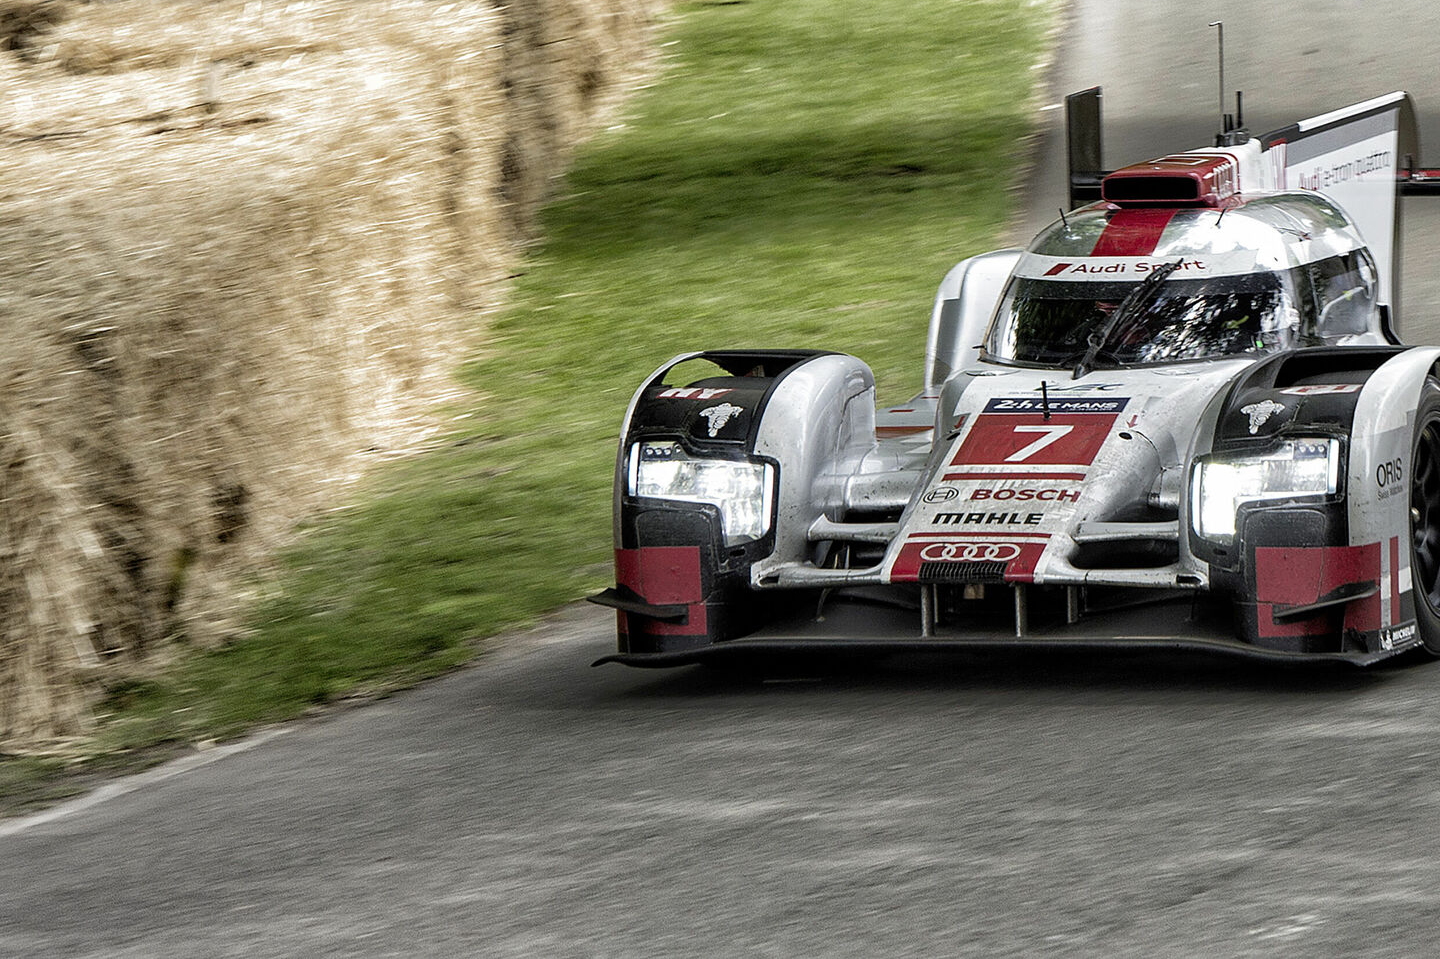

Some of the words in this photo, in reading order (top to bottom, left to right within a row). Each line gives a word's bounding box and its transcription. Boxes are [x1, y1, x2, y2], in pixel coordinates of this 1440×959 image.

[1070, 263, 1126, 274] Audi
[1003, 425, 1075, 462] 7
[1376, 457, 1403, 488] ORIS
[970, 489, 1082, 503] BOSCH
[931, 513, 1044, 525] MAHLE
